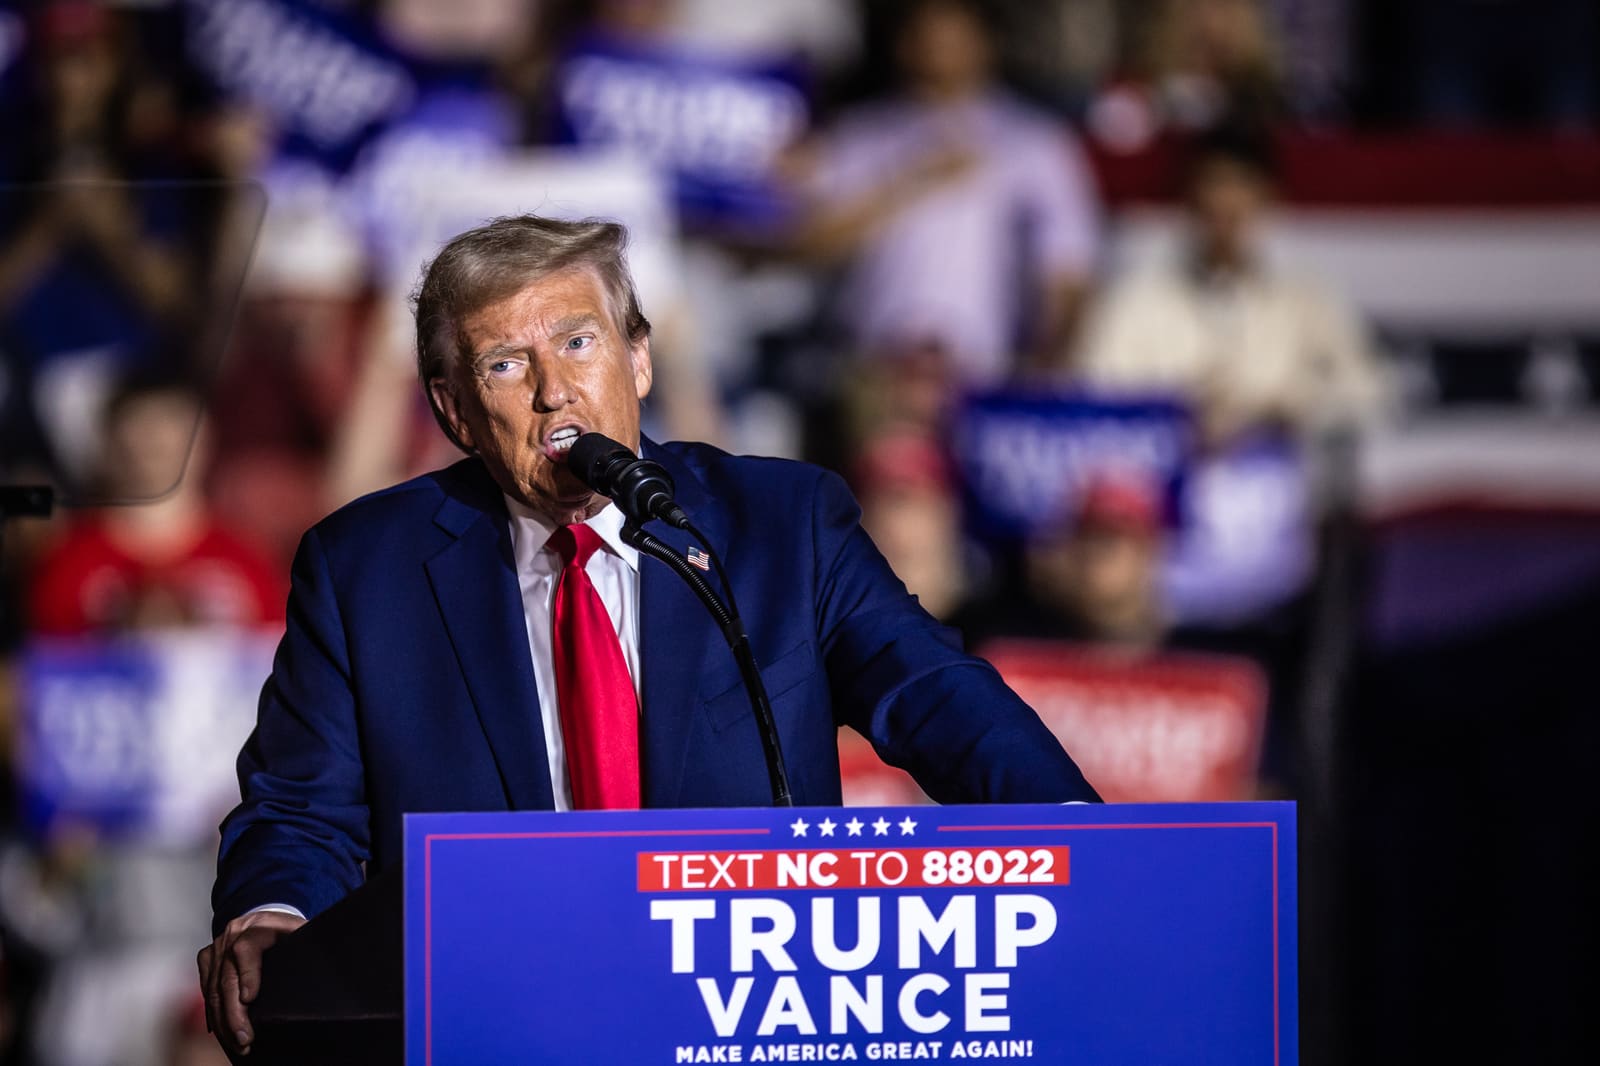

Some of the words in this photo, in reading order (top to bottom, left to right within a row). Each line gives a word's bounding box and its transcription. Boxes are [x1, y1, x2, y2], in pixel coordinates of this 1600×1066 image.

[653, 853, 764, 889] TEXT
[777, 852, 839, 887] NC
[850, 851, 909, 886] TO
[921, 849, 1055, 885] 88022
[650, 894, 1058, 974] TRUMP
[696, 972, 1011, 1037] VANCE
[676, 1045, 742, 1064] MAKE
[750, 1043, 857, 1062] AMERICA
[866, 1041, 943, 1060] GREAT
[950, 1040, 1033, 1058] AGAIN!
